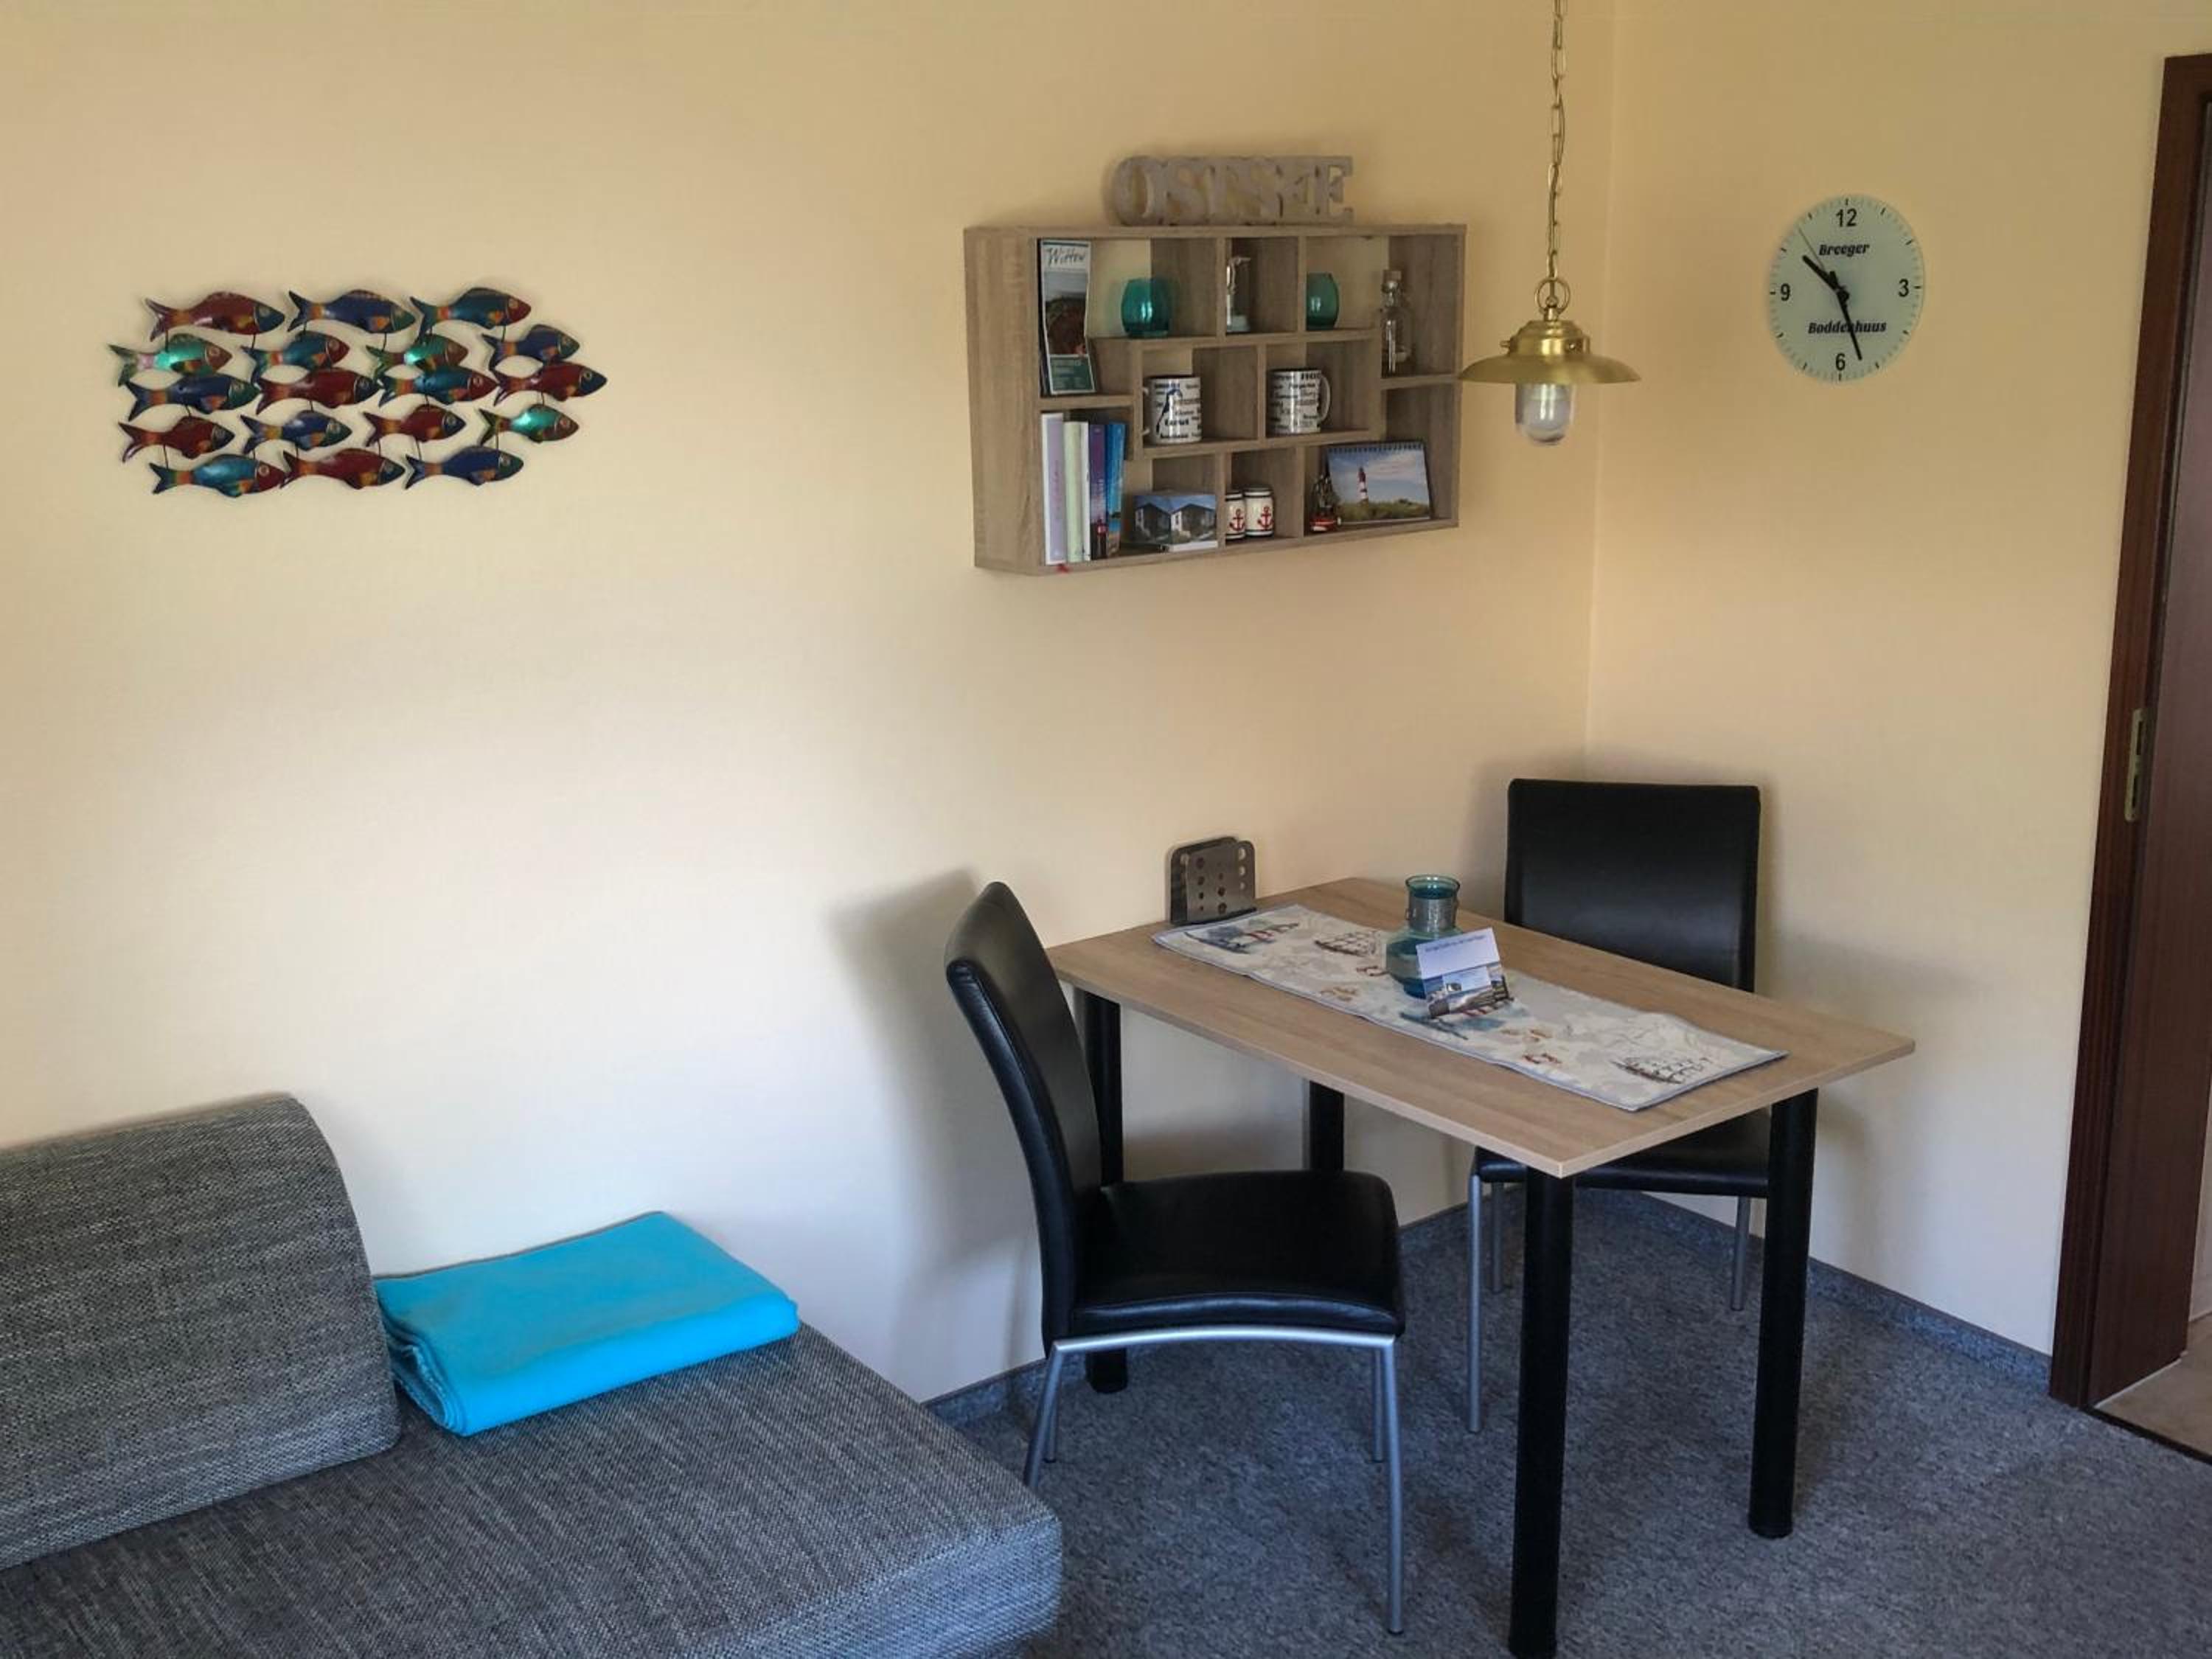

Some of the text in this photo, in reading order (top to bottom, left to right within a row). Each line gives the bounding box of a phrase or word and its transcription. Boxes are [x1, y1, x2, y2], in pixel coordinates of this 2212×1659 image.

[1111, 155, 1353, 226] OSTSEE
[1835, 208, 1857, 227] 12
[1818, 244, 1870, 257] Breeger
[1780, 282, 1791, 302] 9
[1898, 279, 1910, 297] 3
[1834, 352, 1846, 371] 6
